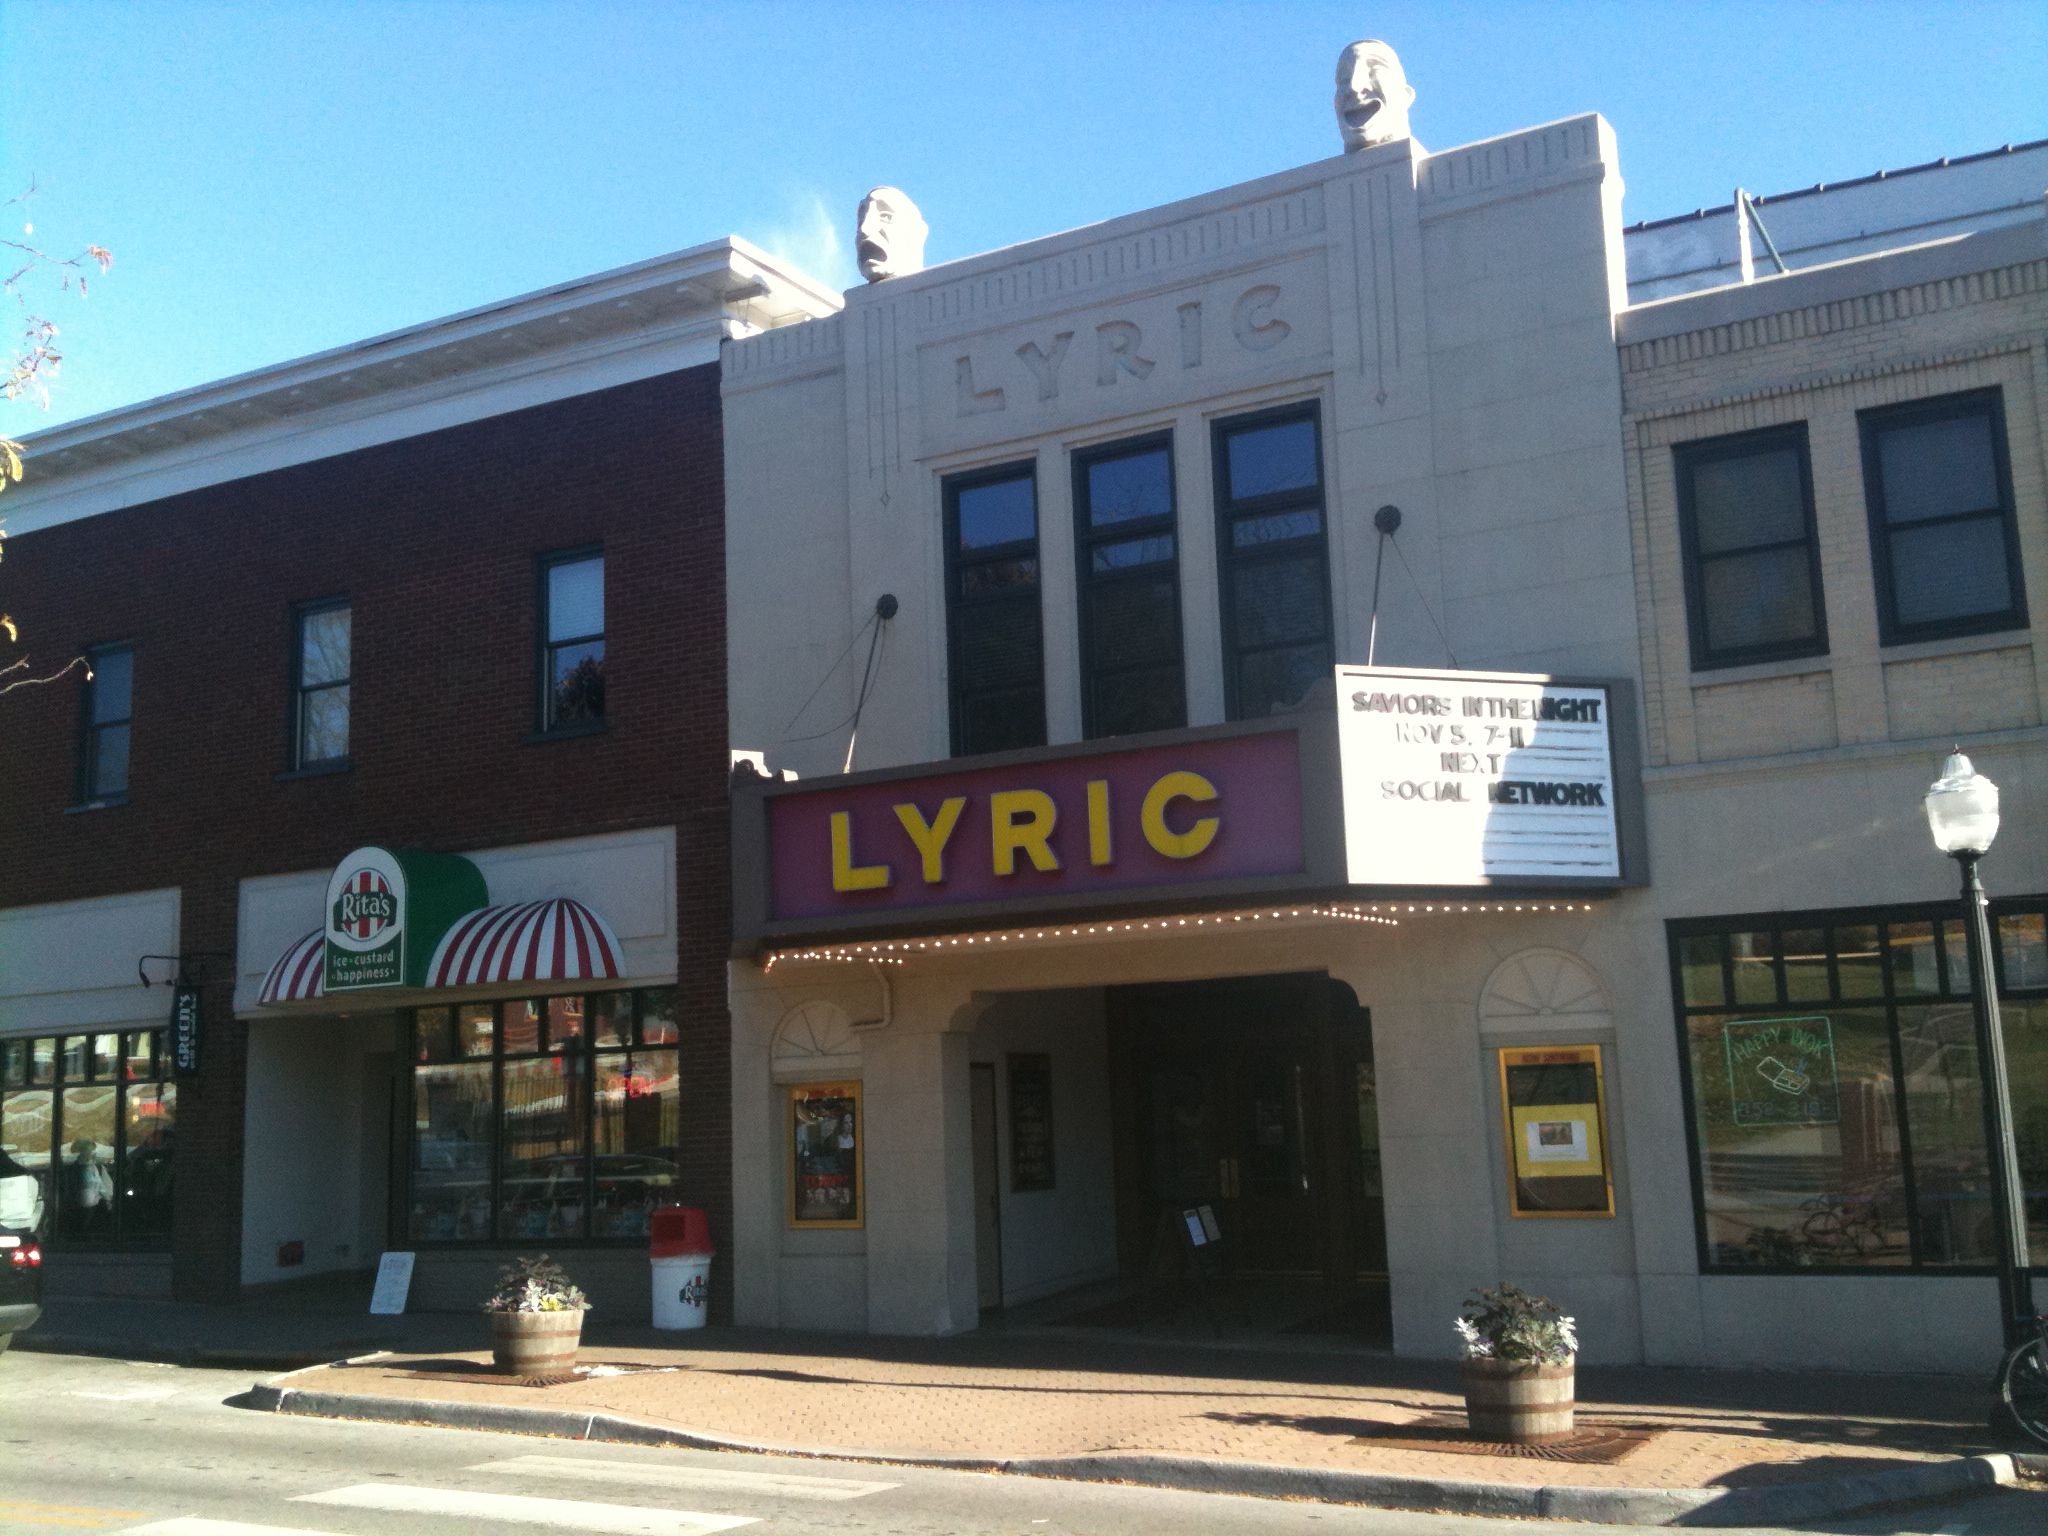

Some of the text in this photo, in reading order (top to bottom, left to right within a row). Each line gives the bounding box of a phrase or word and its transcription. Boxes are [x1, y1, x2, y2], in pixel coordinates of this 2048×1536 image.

[955, 284, 1291, 417] LYRIC
[1352, 691, 1452, 716] SAVIORS
[1396, 722, 1443, 745] NOV
[1440, 752, 1501, 774] NEXT
[1380, 780, 1605, 807] SOCIAL NETWORK
[830, 771, 1220, 892] LYRIC
[342, 892, 391, 921] Rita's
[333, 949, 394, 967] ice custard
[336, 967, 390, 984] happiness
[1734, 1027, 1781, 1063] HAPPY
